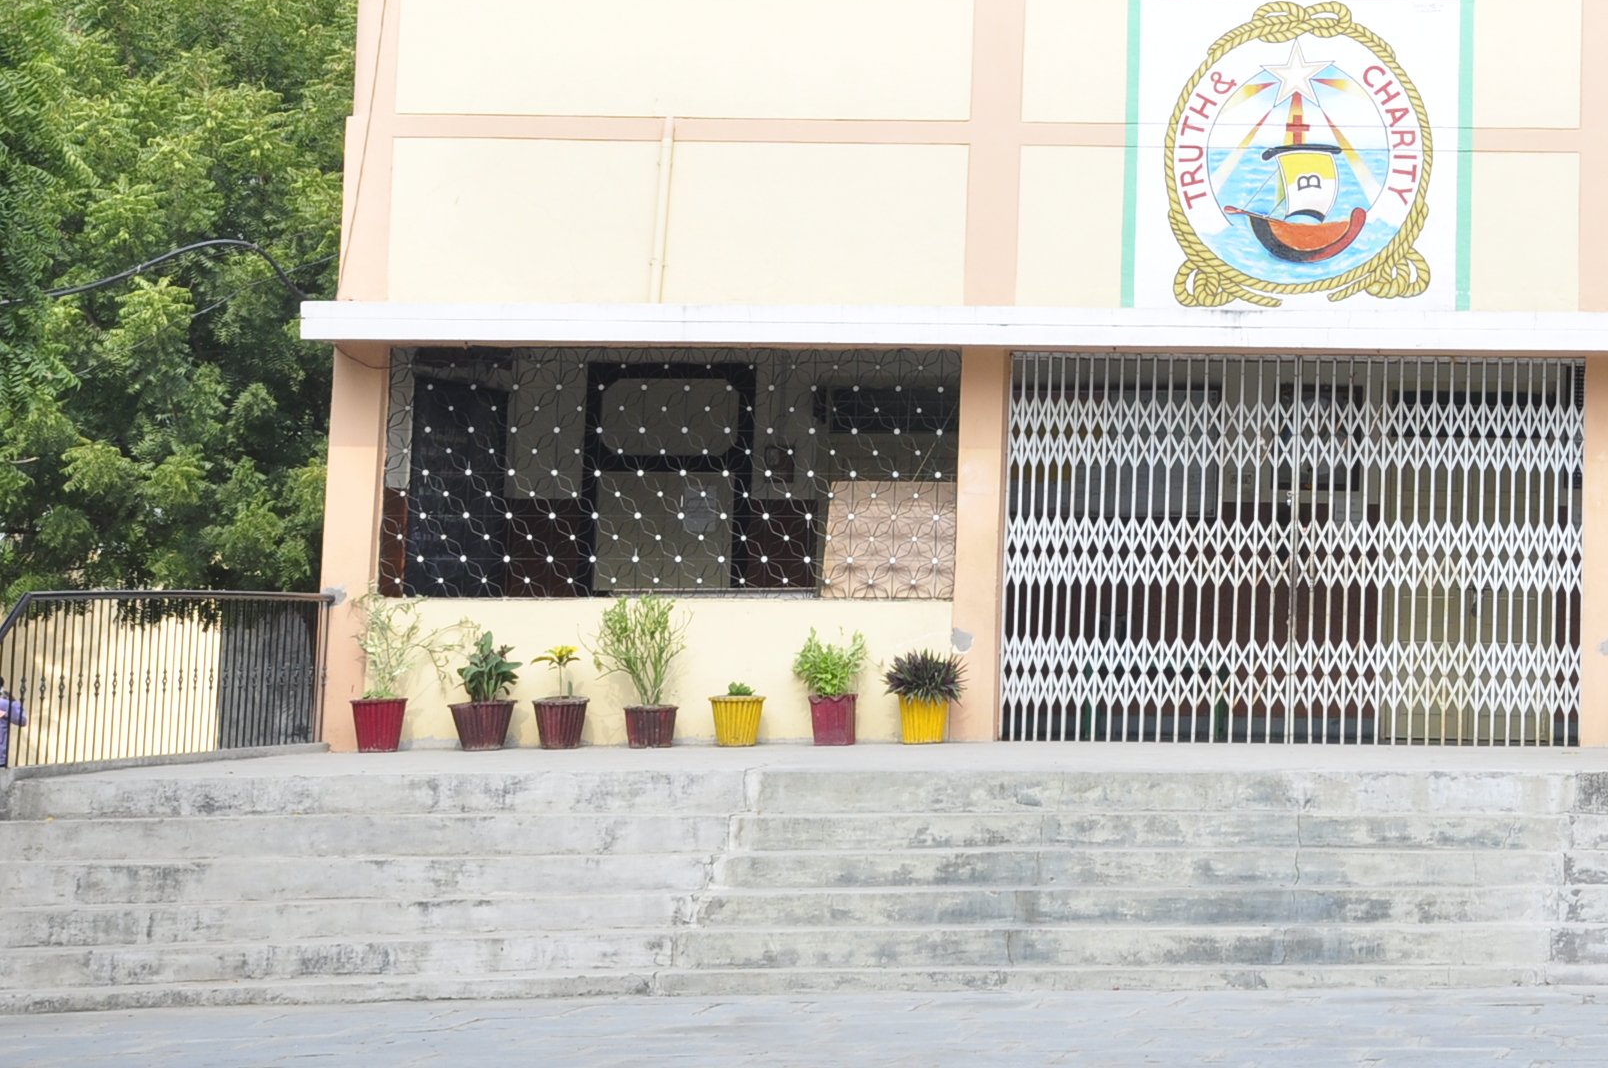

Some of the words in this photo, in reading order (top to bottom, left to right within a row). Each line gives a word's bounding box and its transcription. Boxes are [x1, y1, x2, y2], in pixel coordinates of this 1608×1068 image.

[1178, 91, 1218, 210] TRUTH
[1210, 70, 1238, 95] &
[1362, 64, 1418, 206] CHARITY
